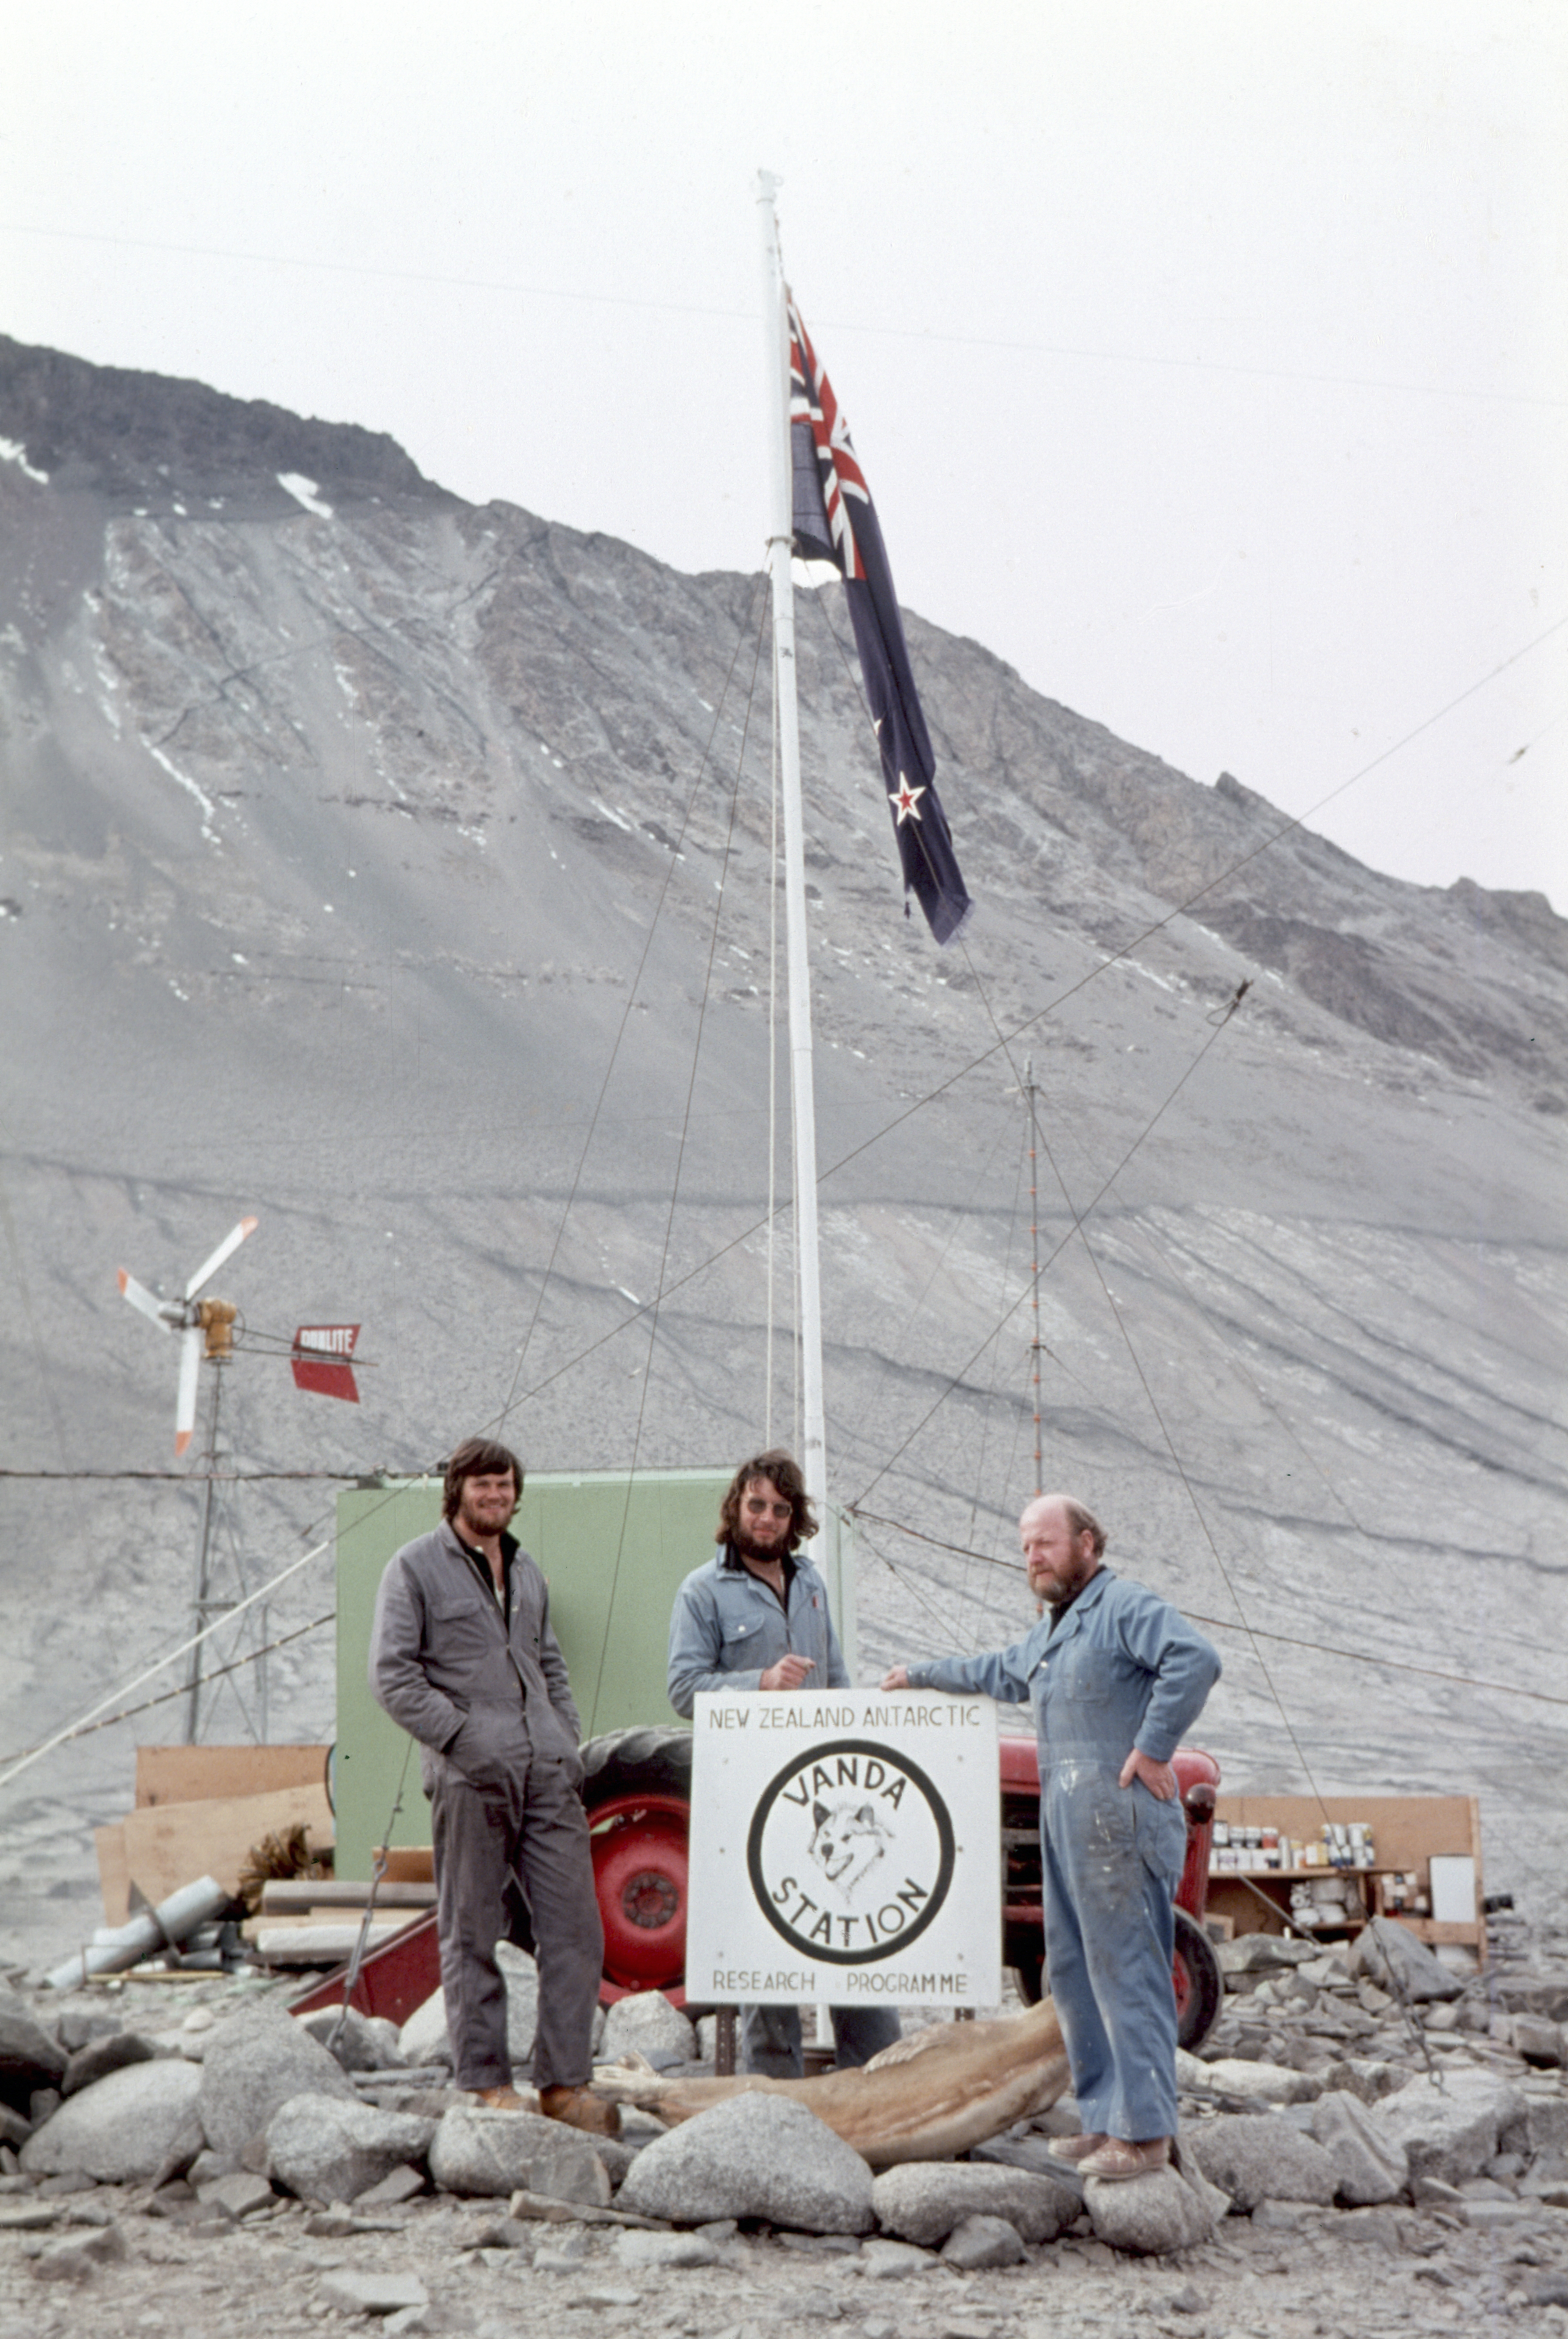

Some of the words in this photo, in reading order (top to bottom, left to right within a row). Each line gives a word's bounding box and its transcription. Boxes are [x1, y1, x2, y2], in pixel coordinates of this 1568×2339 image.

[710, 1708, 750, 1729] NEW
[759, 1707, 856, 1729] ZEALAND
[863, 1704, 980, 1727] ANTARCTIC
[782, 1757, 907, 1811] VANDA
[771, 1877, 929, 1947] STATION
[713, 1970, 815, 1991] RESEARCH
[847, 1973, 967, 1994] PROGRAMME
